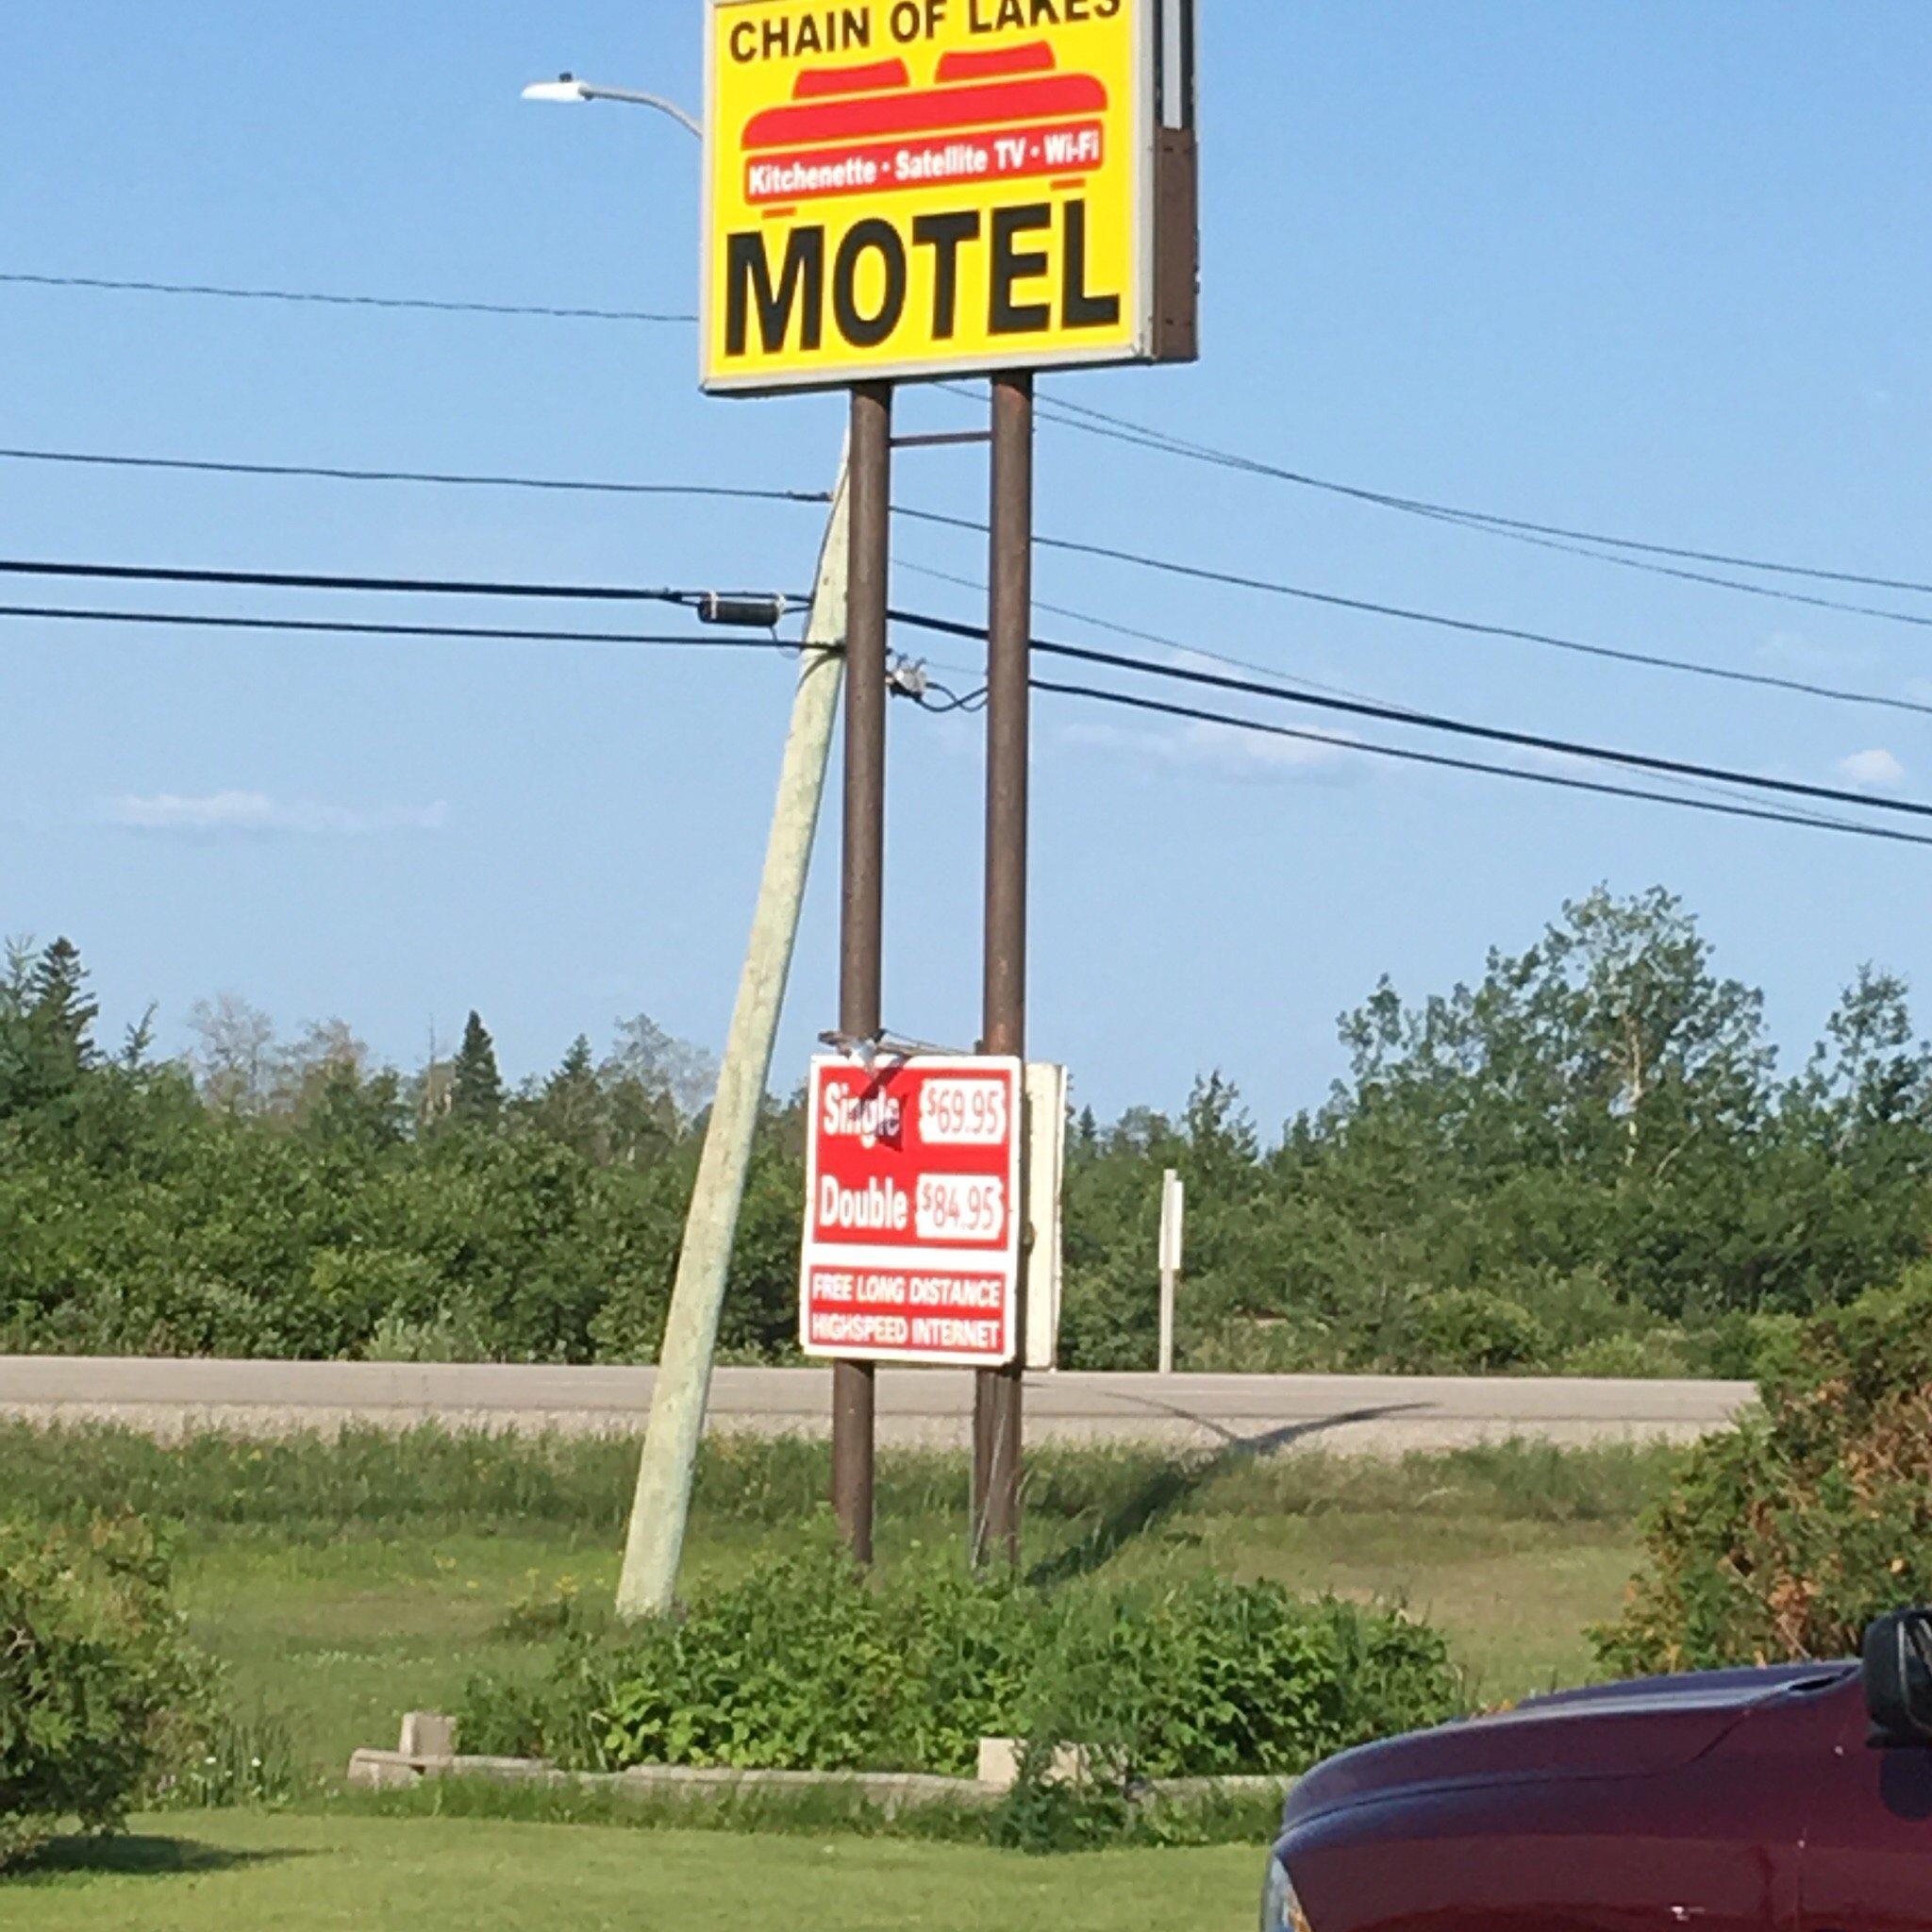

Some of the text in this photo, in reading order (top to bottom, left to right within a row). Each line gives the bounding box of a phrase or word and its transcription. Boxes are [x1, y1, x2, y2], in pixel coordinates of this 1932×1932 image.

[729, 8, 869, 63] CHAIN
[891, 1, 945, 43] OF
[749, 129, 1099, 194] Kitchenette Satellite TV Wi-Fi
[724, 198, 1120, 357] MOTEL
[824, 1082, 999, 1148] Single $69.95
[819, 1174, 995, 1230] Double $84.95
[812, 1273, 1001, 1307] FREE LONG DISTANCE
[812, 1312, 1000, 1349] HIGHSPEED INTERNET
